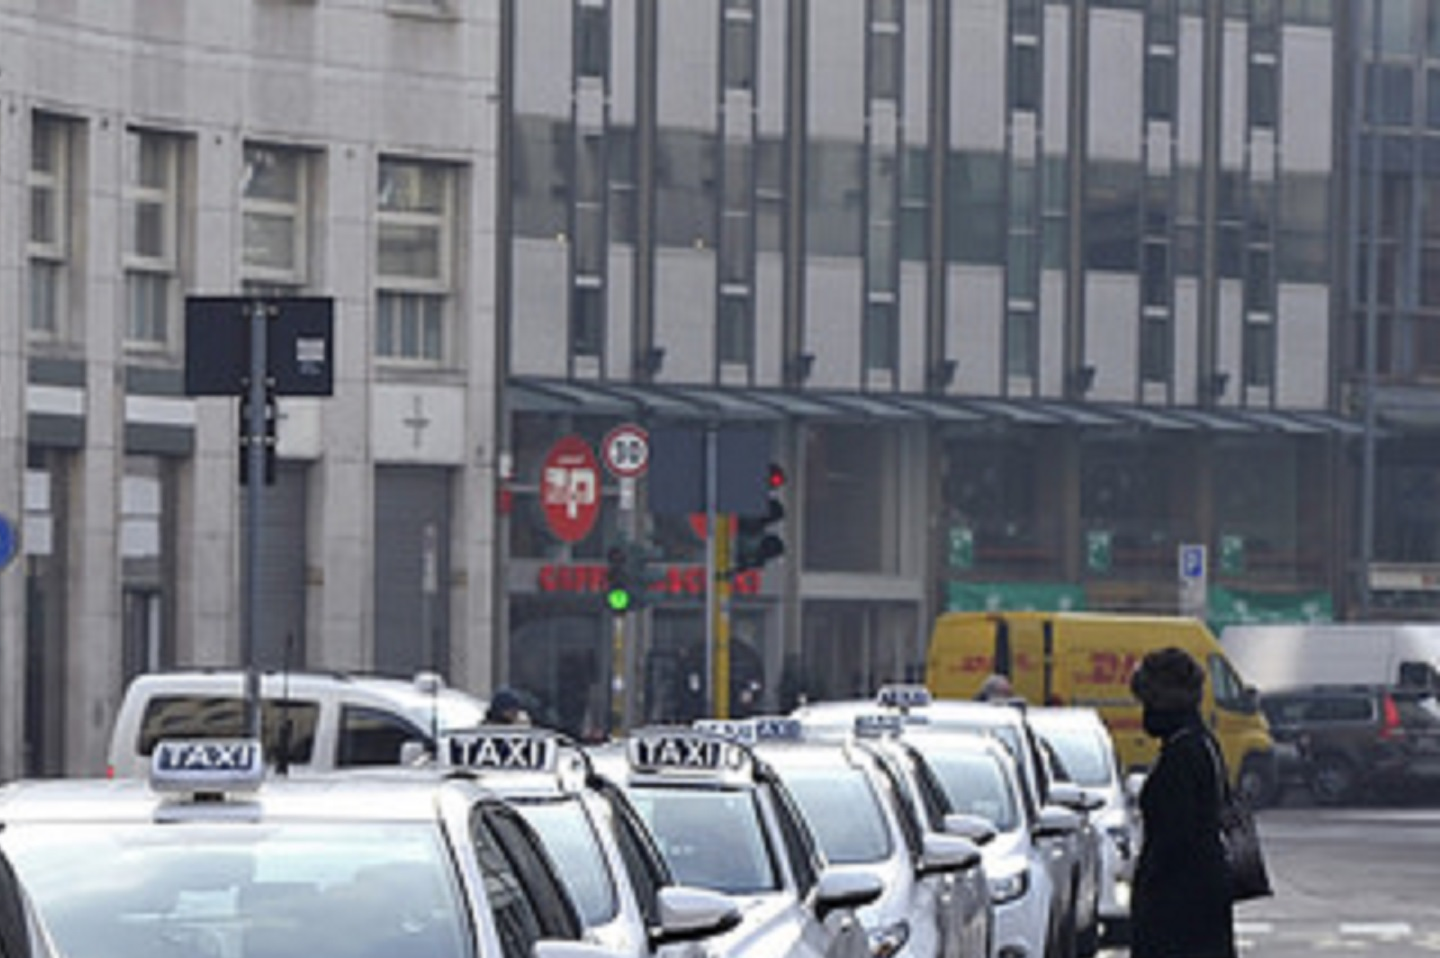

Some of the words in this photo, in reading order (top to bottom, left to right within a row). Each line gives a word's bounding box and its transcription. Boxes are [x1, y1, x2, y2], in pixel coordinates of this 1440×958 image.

[163, 742, 249, 767] TAXI
[454, 736, 537, 767] TAXI
[642, 736, 713, 767] TAXI
